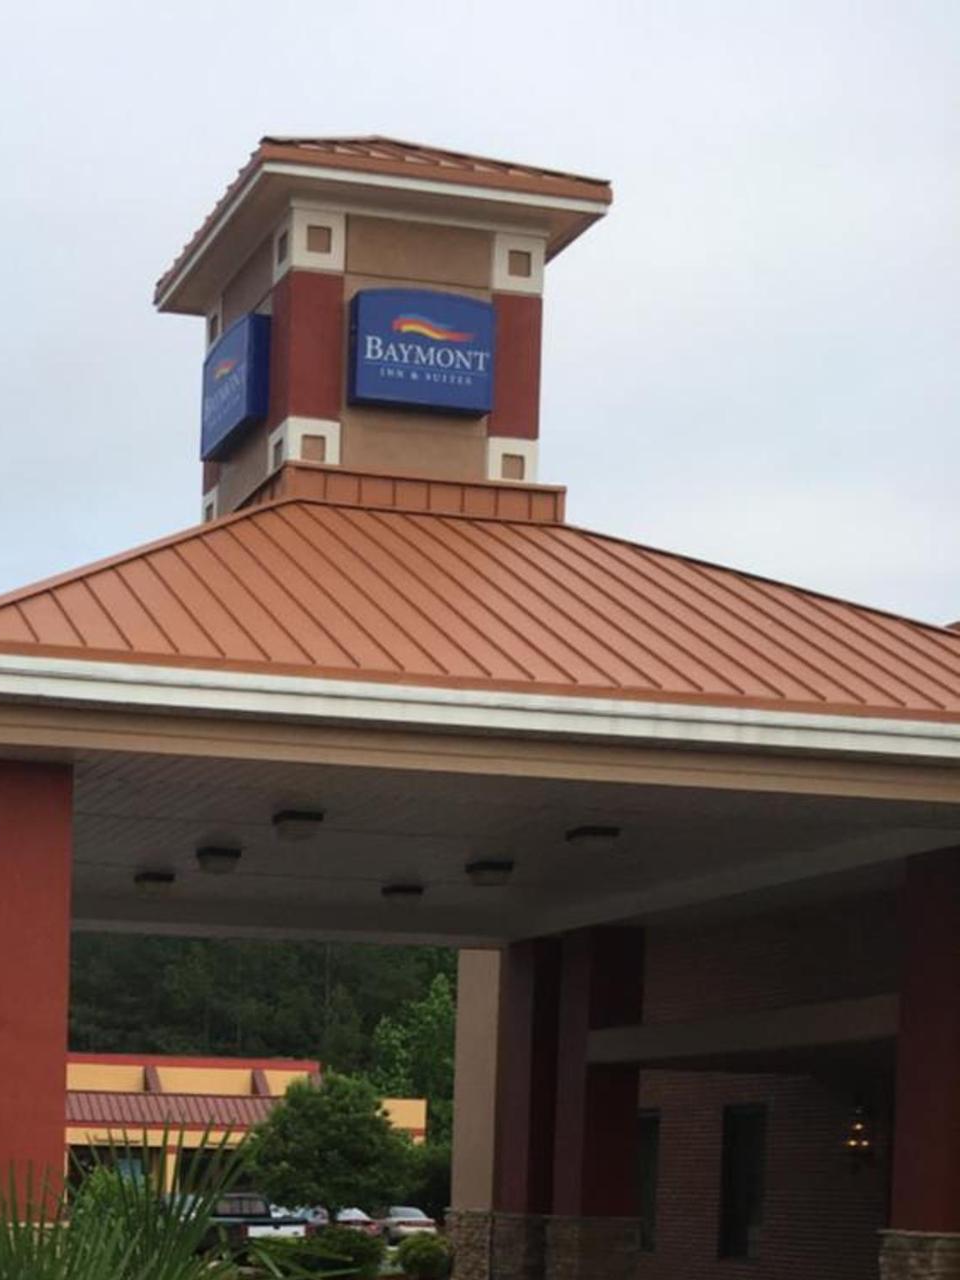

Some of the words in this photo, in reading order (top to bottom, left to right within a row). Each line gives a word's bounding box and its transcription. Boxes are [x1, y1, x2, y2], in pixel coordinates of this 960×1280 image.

[365, 335, 490, 371] BAYMONT
[380, 367, 404, 379] INN
[426, 373, 472, 385] SUITES
